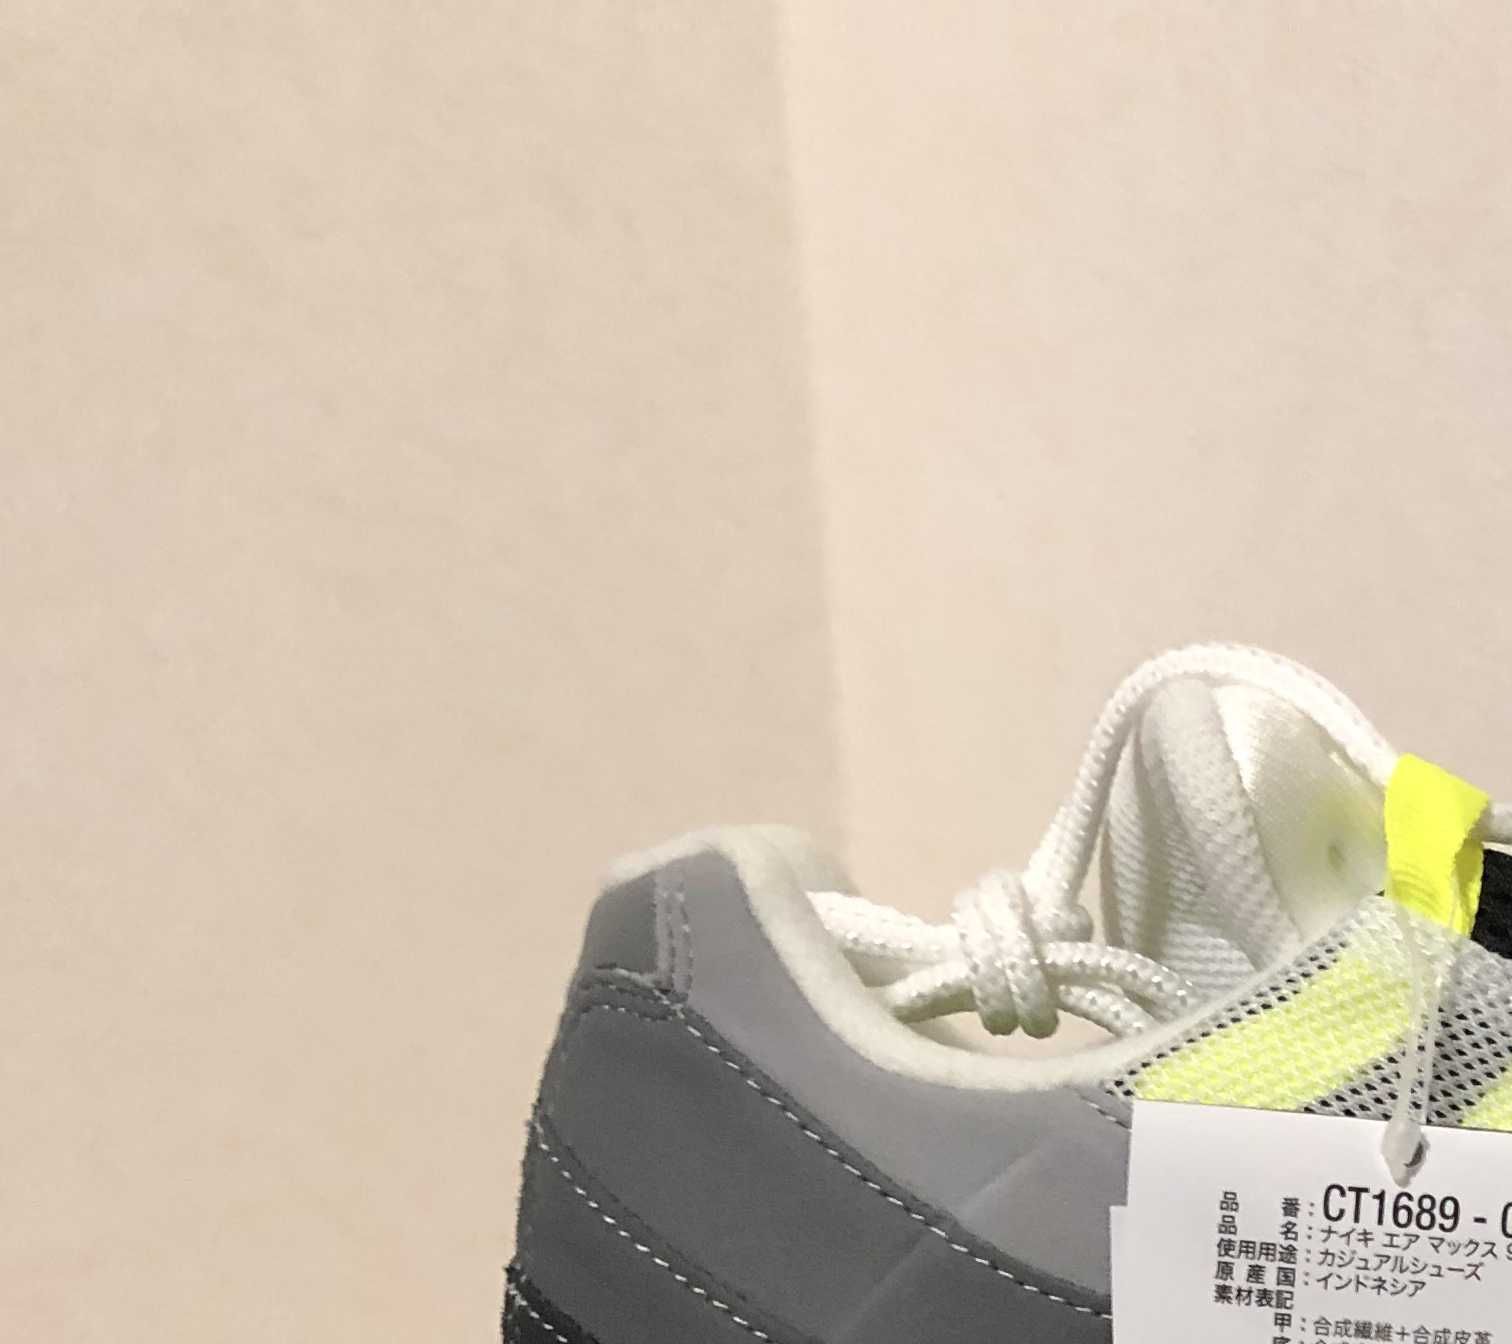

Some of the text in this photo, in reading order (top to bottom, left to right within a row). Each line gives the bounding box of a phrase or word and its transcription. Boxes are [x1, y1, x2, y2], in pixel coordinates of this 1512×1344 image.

[1322, 1183, 1461, 1233] CT1689
[1319, 1225, 1375, 1249] ナイキ
[1382, 1231, 1420, 1251] エア
[1428, 1236, 1498, 1259] マックス
[1315, 1272, 1426, 1297] インドネシア
